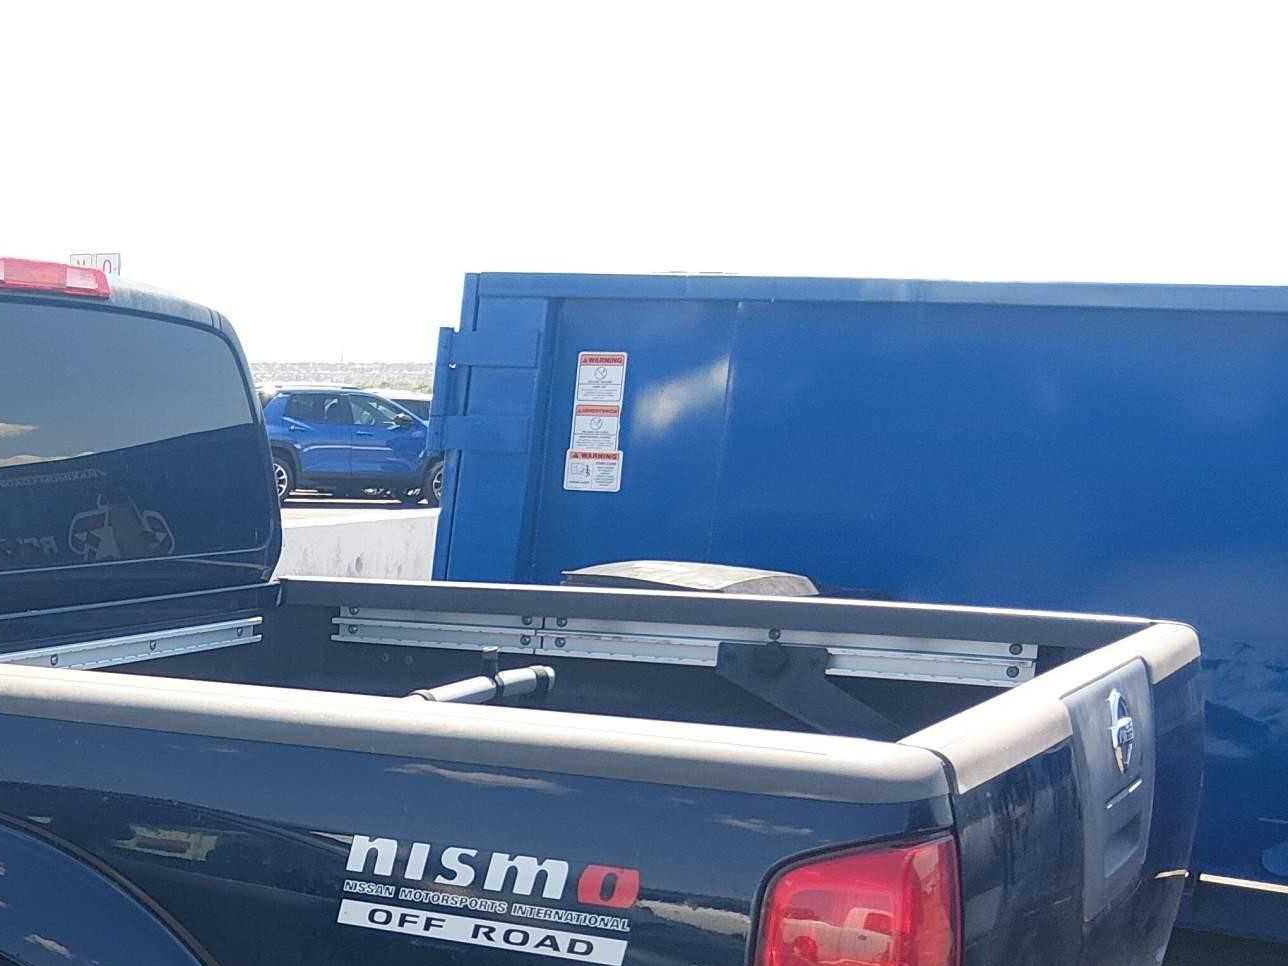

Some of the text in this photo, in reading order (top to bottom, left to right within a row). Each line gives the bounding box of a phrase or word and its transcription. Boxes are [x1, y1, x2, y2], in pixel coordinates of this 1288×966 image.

[581, 452, 617, 460] WARNING
[345, 834, 640, 909] nismo
[343, 879, 631, 931] NISSAN MOTORSPORTS INTERNATIONAL
[367, 907, 595, 957] OFF ROAD
